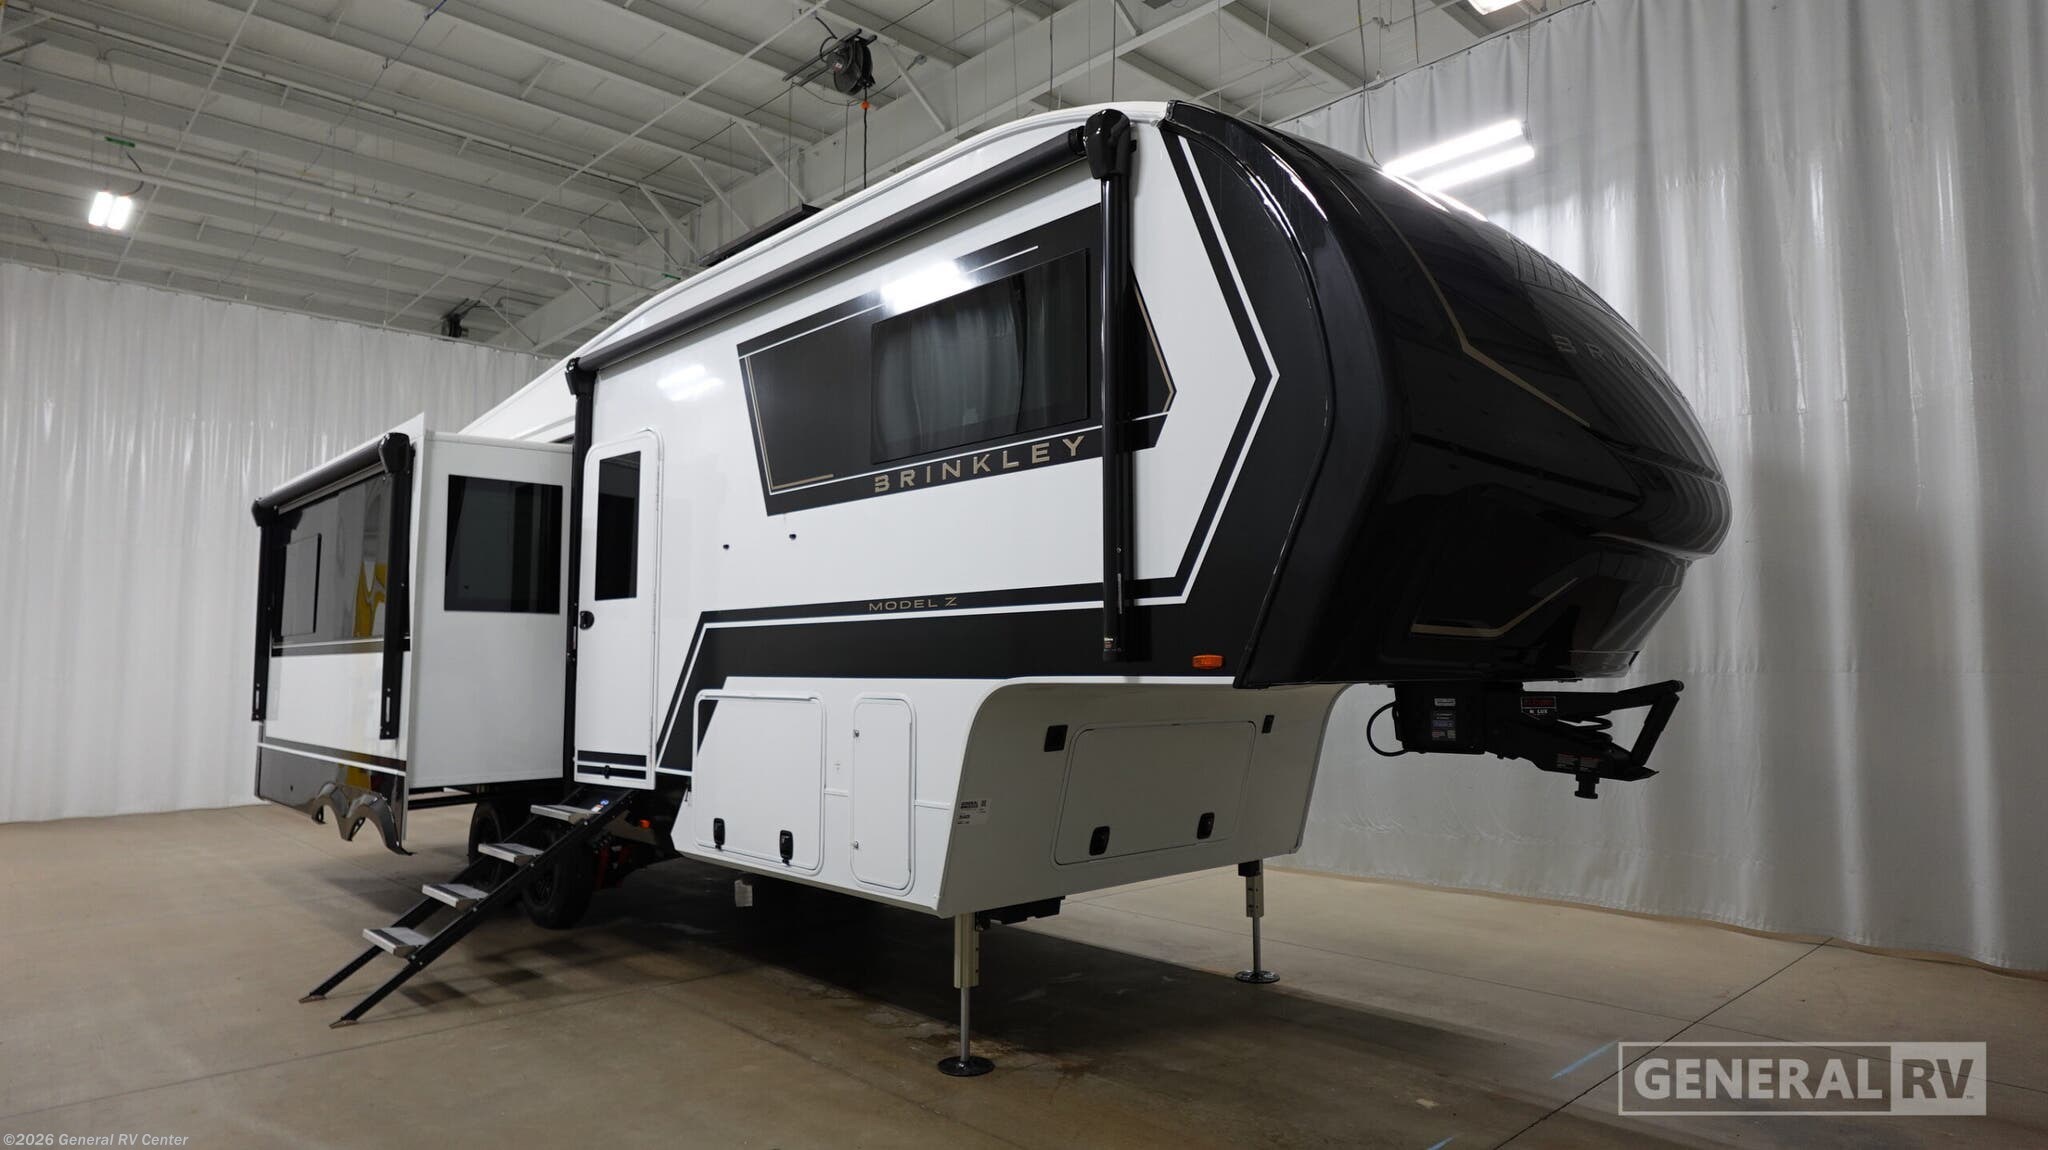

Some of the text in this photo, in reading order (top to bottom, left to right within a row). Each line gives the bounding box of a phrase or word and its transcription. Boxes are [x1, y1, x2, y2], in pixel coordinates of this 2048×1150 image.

[874, 435, 1085, 493] BRINKLEY
[869, 596, 958, 611] MODEL Z
